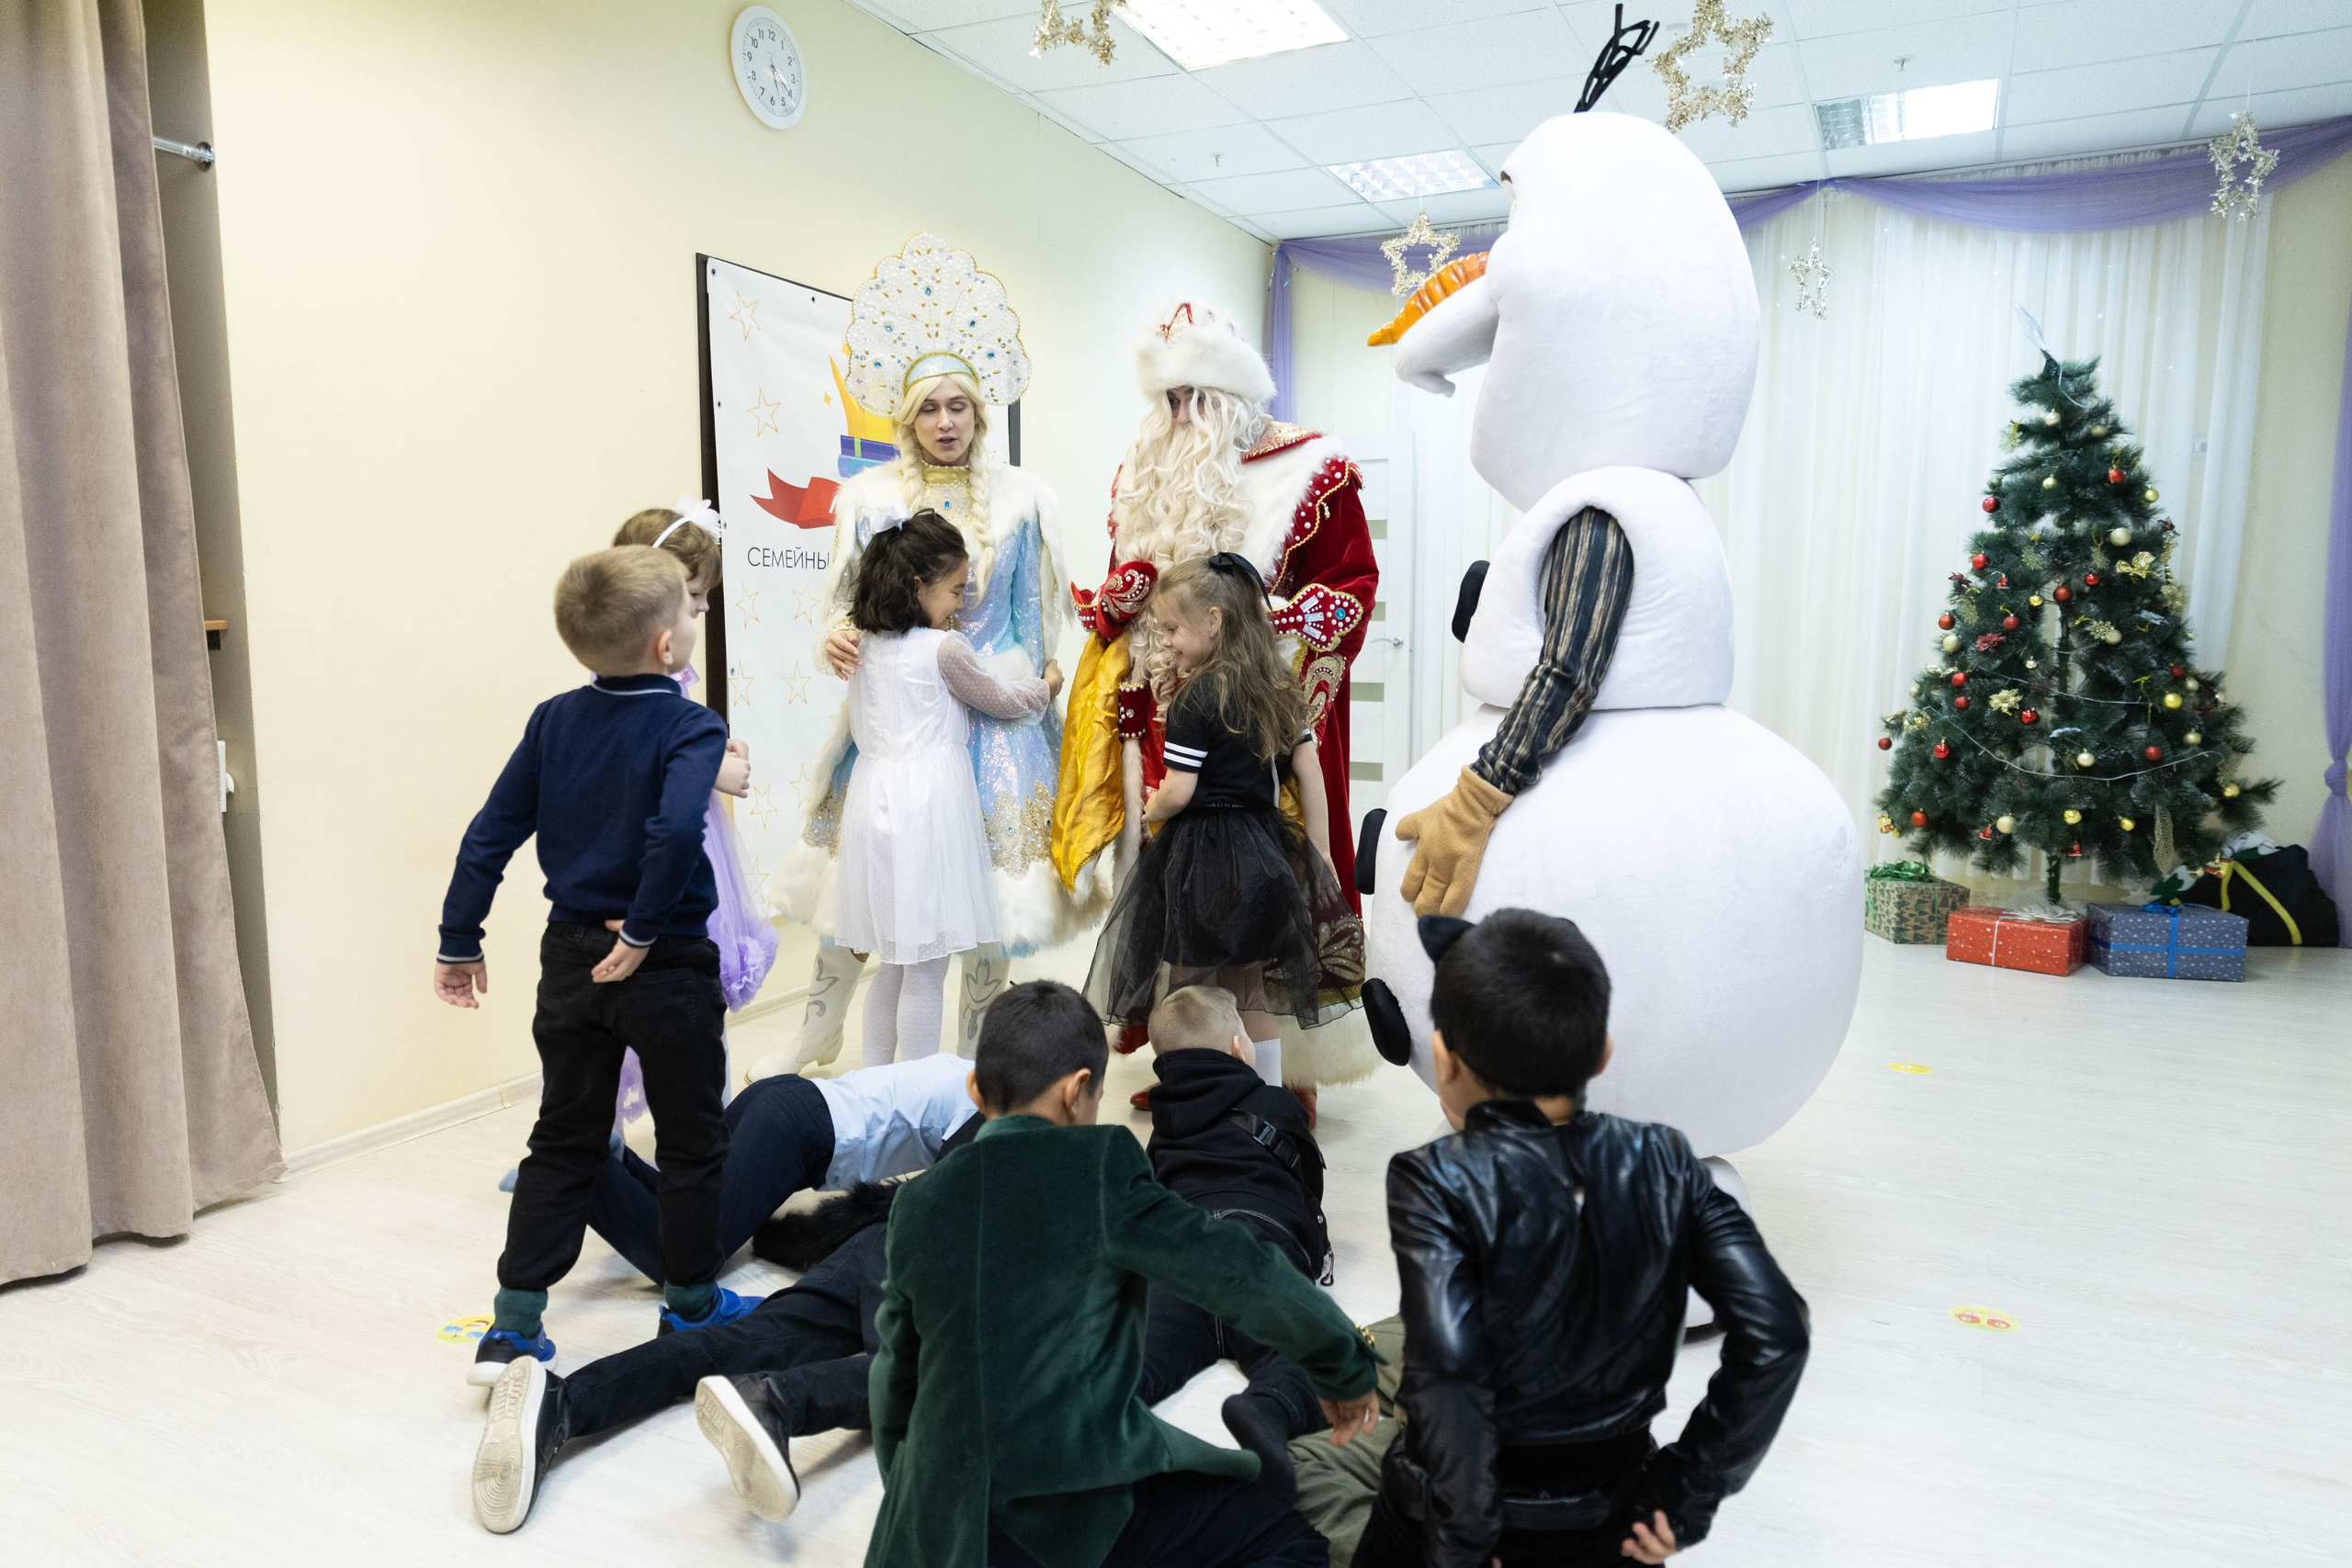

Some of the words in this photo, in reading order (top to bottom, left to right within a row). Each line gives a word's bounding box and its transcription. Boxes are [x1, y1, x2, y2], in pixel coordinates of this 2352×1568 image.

[758, 28, 764, 40] 11
[768, 28, 775, 41] 12
[751, 37, 758, 49] 10
[780, 40, 784, 51] 1
[747, 51, 752, 62] 9
[787, 56, 792, 66] 2
[751, 70, 756, 81] 8
[791, 73, 796, 84] 3
[760, 86, 764, 96] 7
[770, 96, 775, 106] 6
[781, 96, 786, 107] 5
